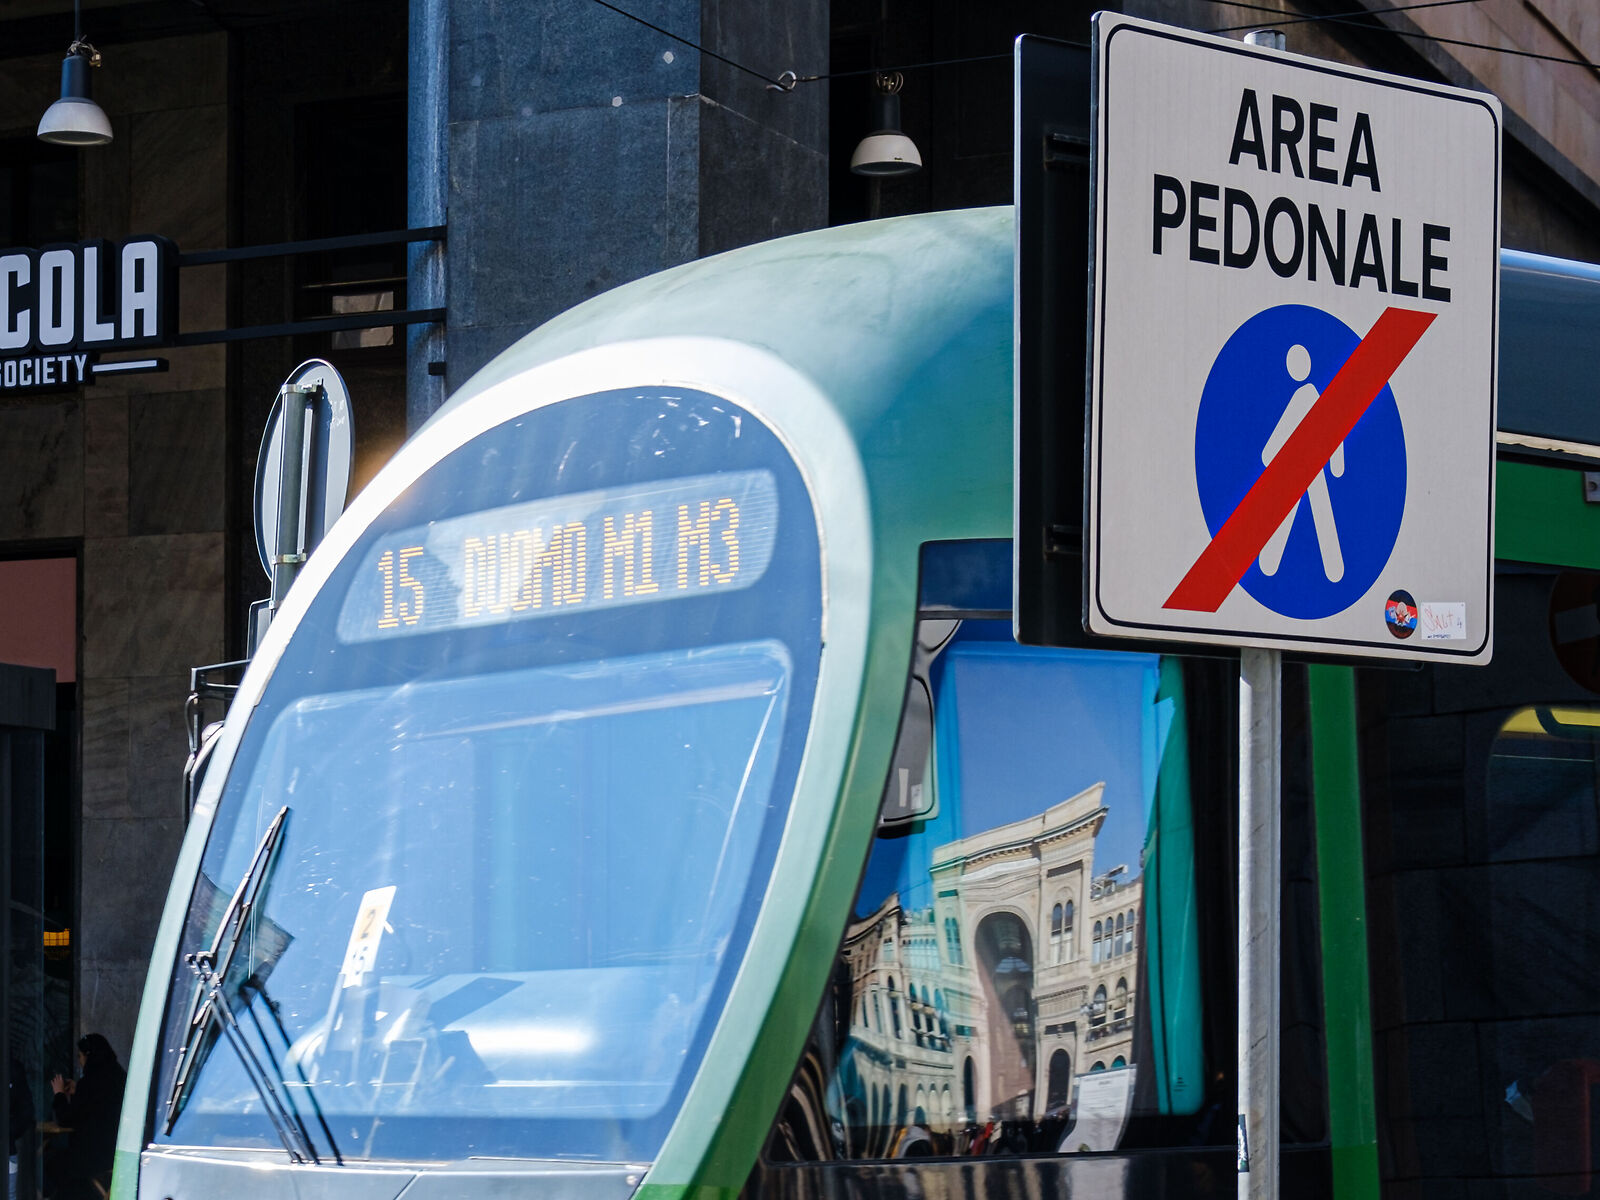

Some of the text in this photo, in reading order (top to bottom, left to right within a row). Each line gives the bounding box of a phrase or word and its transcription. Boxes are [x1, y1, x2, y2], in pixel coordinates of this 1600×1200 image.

[1229, 88, 1381, 192] AREA
[1153, 173, 1451, 303] PEDONALE
[0, 241, 158, 349] COLA
[0, 354, 87, 388] OCIETY
[378, 498, 739, 628] 15 DUOMO M1 M3
[360, 908, 377, 940] 2
